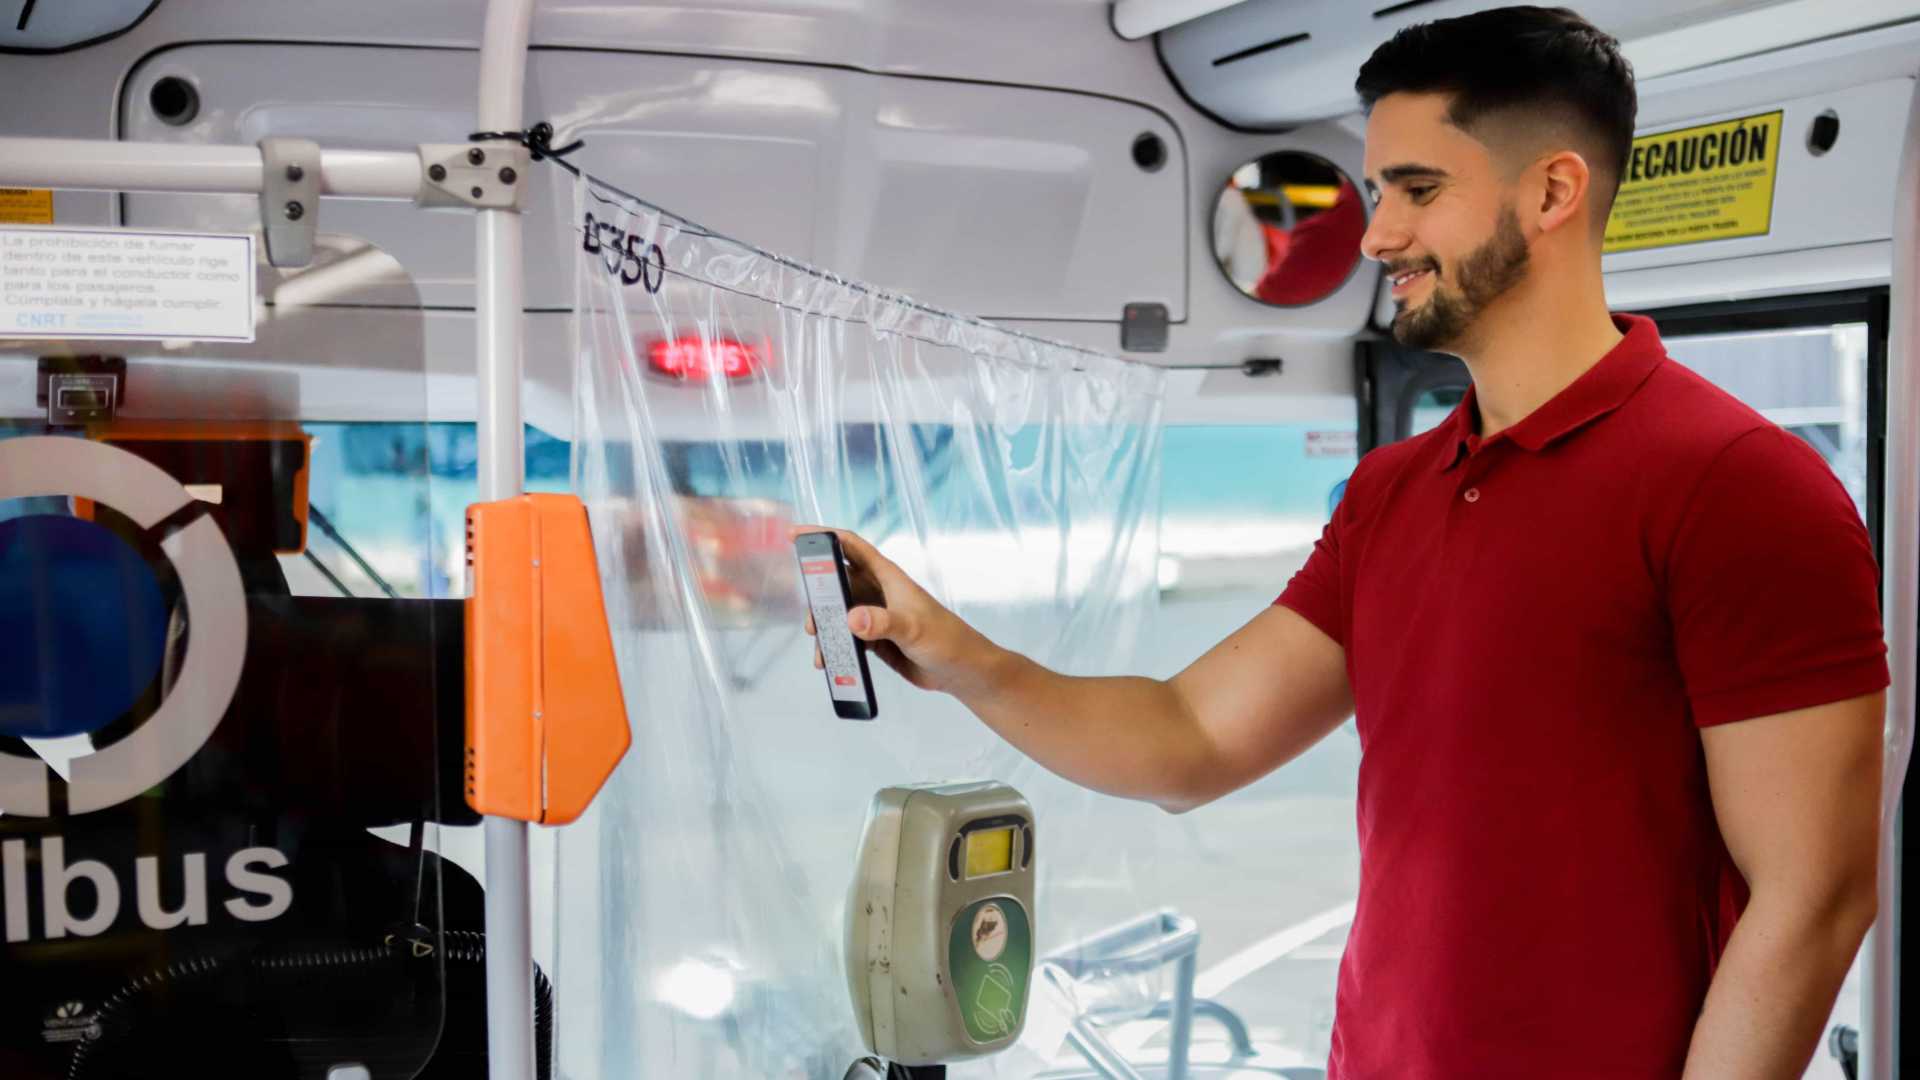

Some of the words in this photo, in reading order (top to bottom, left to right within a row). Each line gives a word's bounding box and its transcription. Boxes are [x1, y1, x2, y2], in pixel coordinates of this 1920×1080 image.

[1621, 121, 1768, 182] ECAUCIÓN
[3, 235, 23, 248] La
[29, 236, 120, 251] prohibición
[124, 240, 145, 250] de
[149, 240, 195, 251] fumar
[3, 249, 55, 262] dentro
[61, 251, 83, 262] de
[88, 253, 121, 264] este
[128, 253, 195, 266] vehículo
[200, 257, 229, 268] rige
[3, 264, 46, 277] tanto
[51, 268, 87, 279] para
[93, 266, 108, 277] el
[112, 268, 192, 280] conductor
[196, 271, 241, 282] como
[4, 280, 41, 293] para
[46, 280, 71, 291] los
[76, 282, 160, 295] pasajeros.
[16, 312, 66, 328] CNRT
